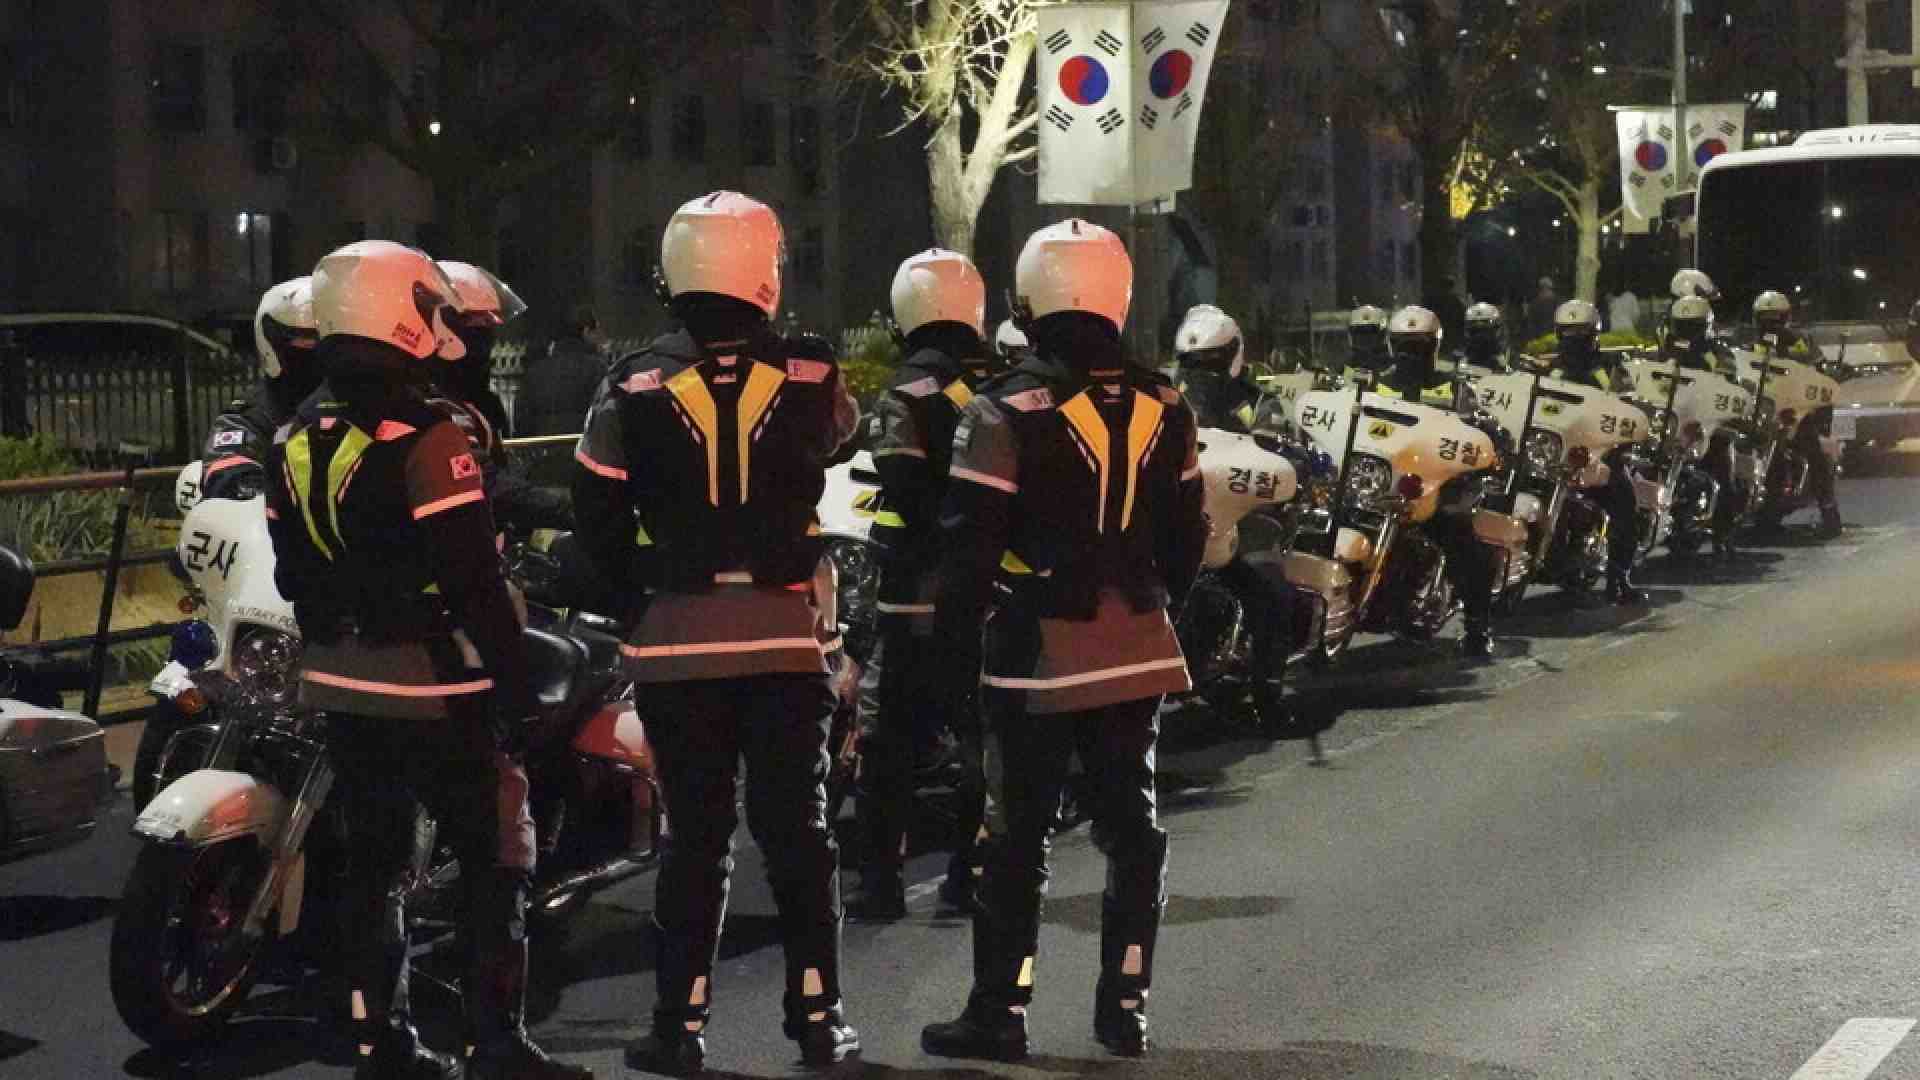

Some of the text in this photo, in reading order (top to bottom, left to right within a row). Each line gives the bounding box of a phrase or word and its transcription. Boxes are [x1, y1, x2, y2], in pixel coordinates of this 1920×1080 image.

[1480, 388, 1637, 437] 군사 경찰
[1714, 393, 1746, 413] 경찰
[1302, 405, 1480, 465] 군사 경찰
[181, 481, 200, 511] 군
[1229, 467, 1280, 499] 경찰
[186, 531, 239, 579] 군사
